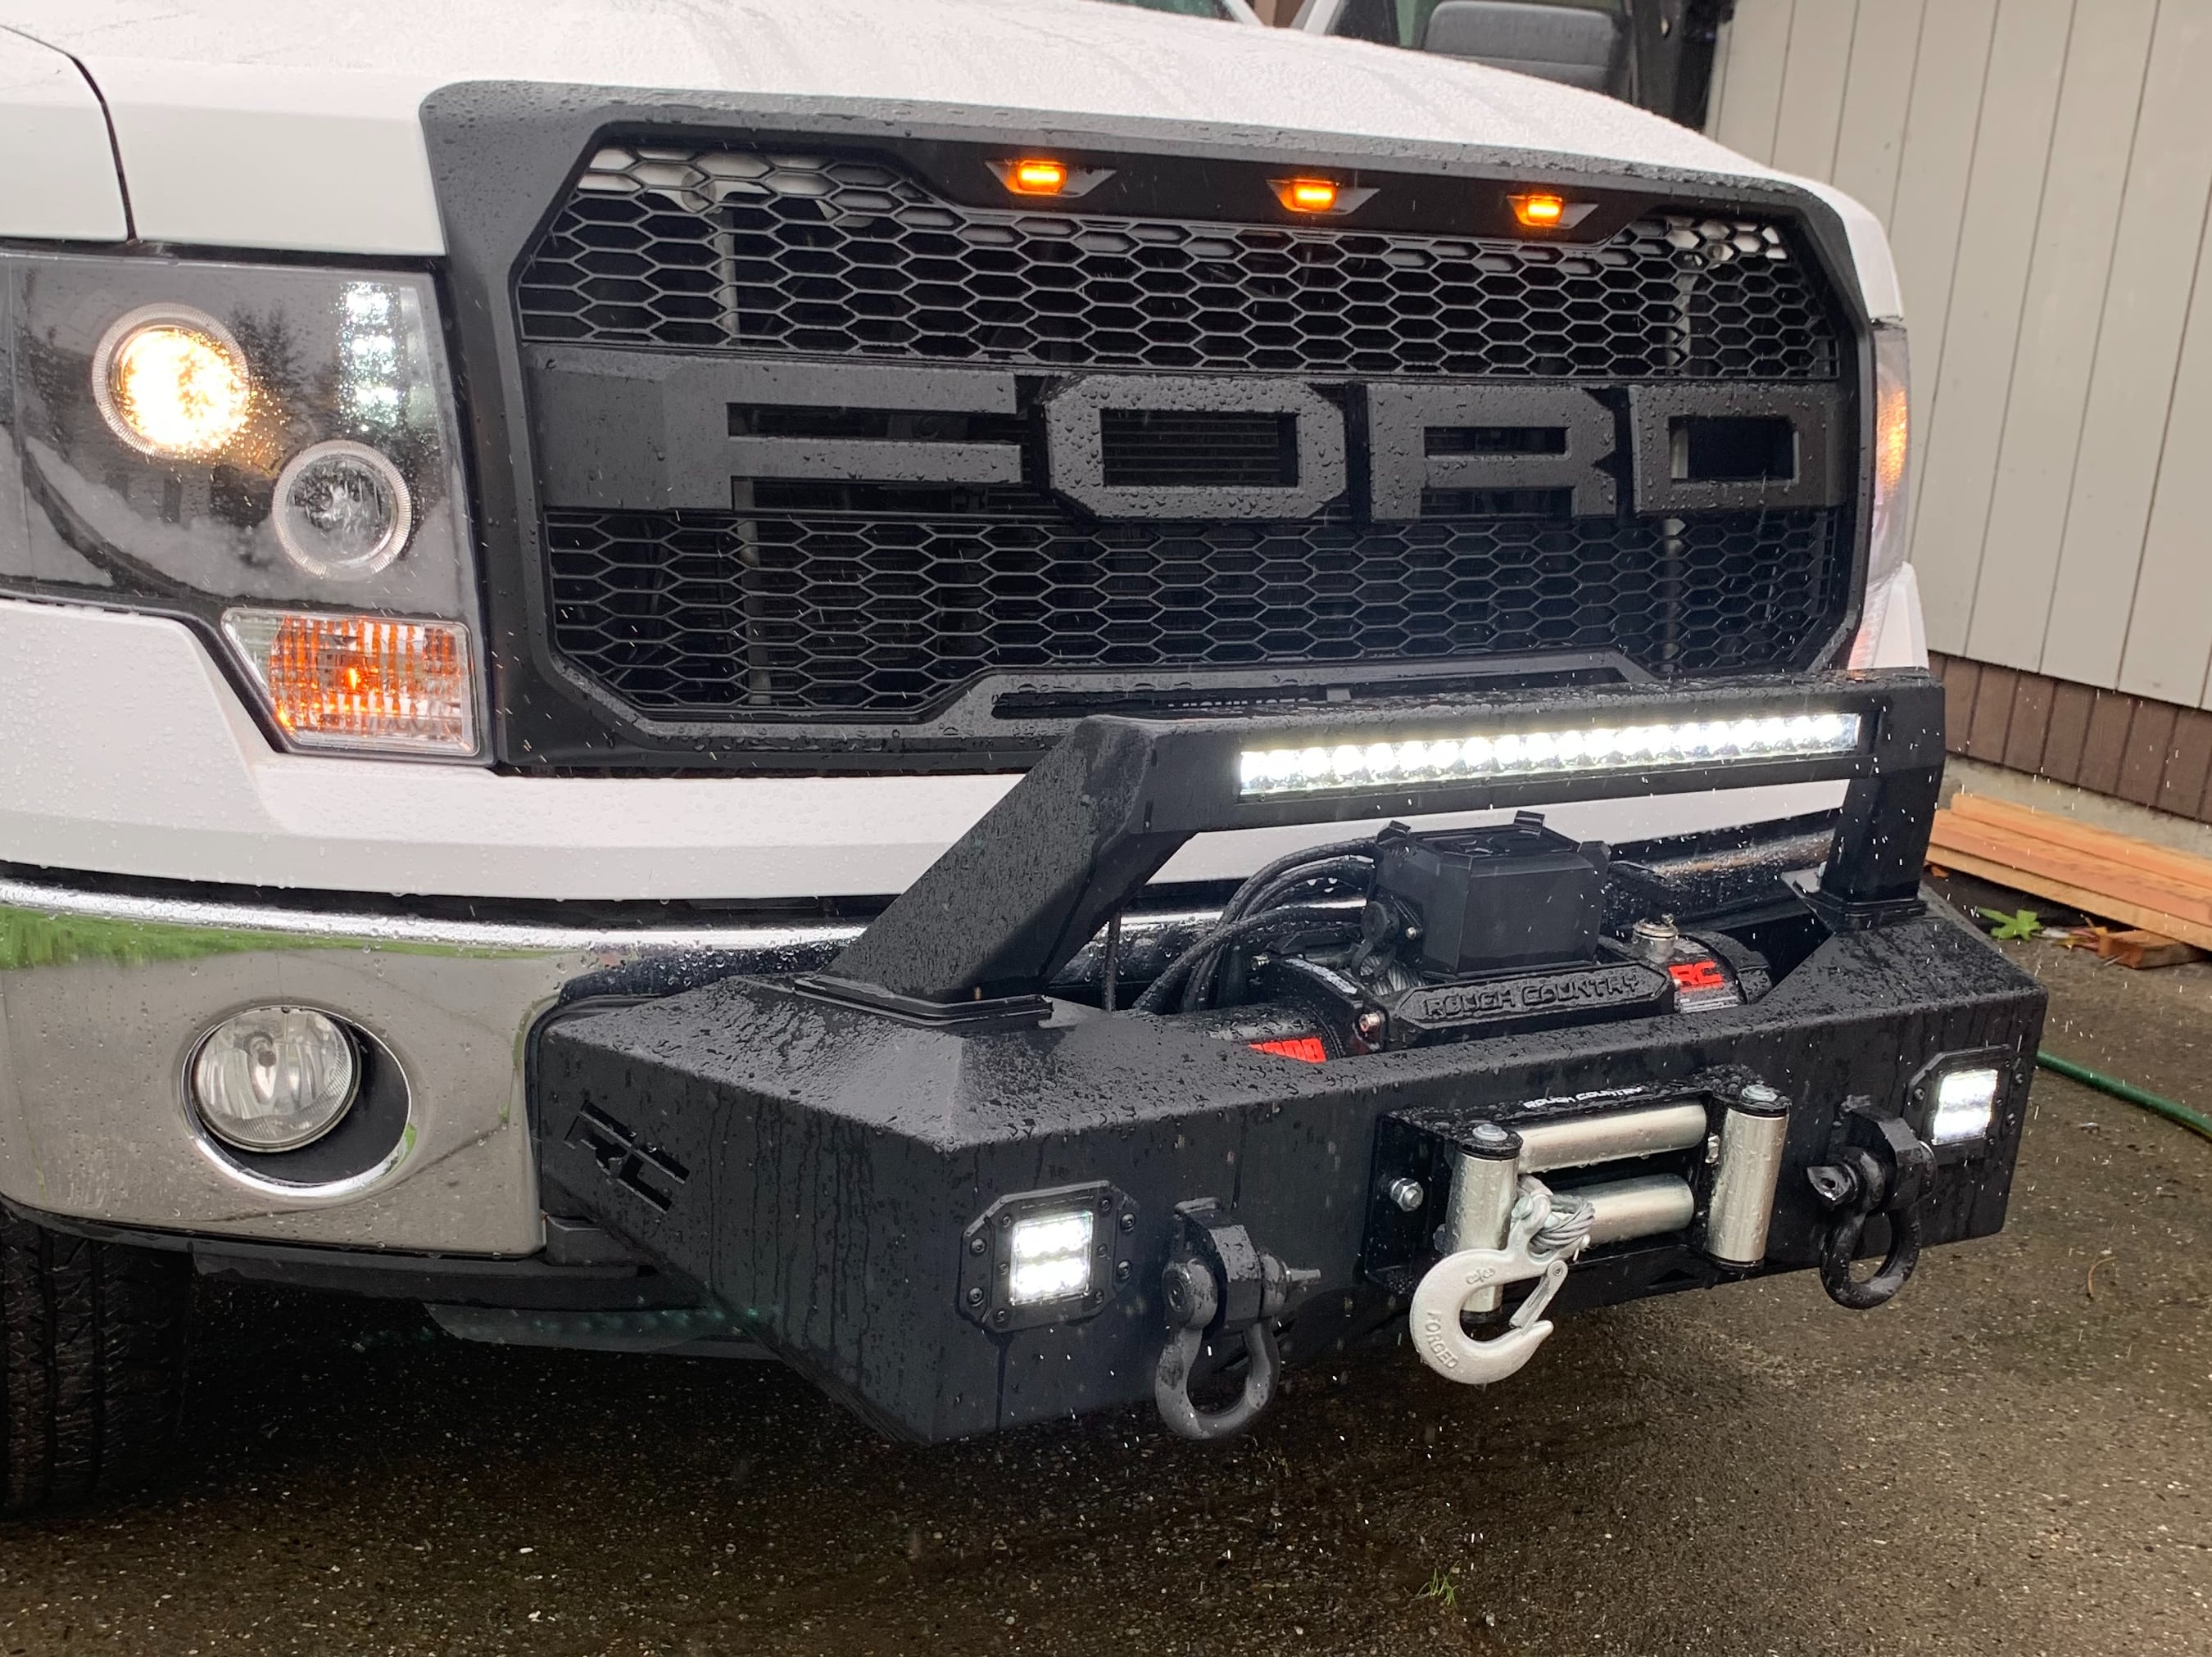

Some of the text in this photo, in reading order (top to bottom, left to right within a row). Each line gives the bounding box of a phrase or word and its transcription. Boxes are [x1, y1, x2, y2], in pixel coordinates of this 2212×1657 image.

[528, 347, 1842, 524] FORD
[1668, 959, 1724, 986] RC
[1424, 973, 1639, 1017] ROUGH COUNTRY
[1523, 1085, 1643, 1109] ROUGH COUNTRY
[1424, 1311, 1459, 1370] FORGED
